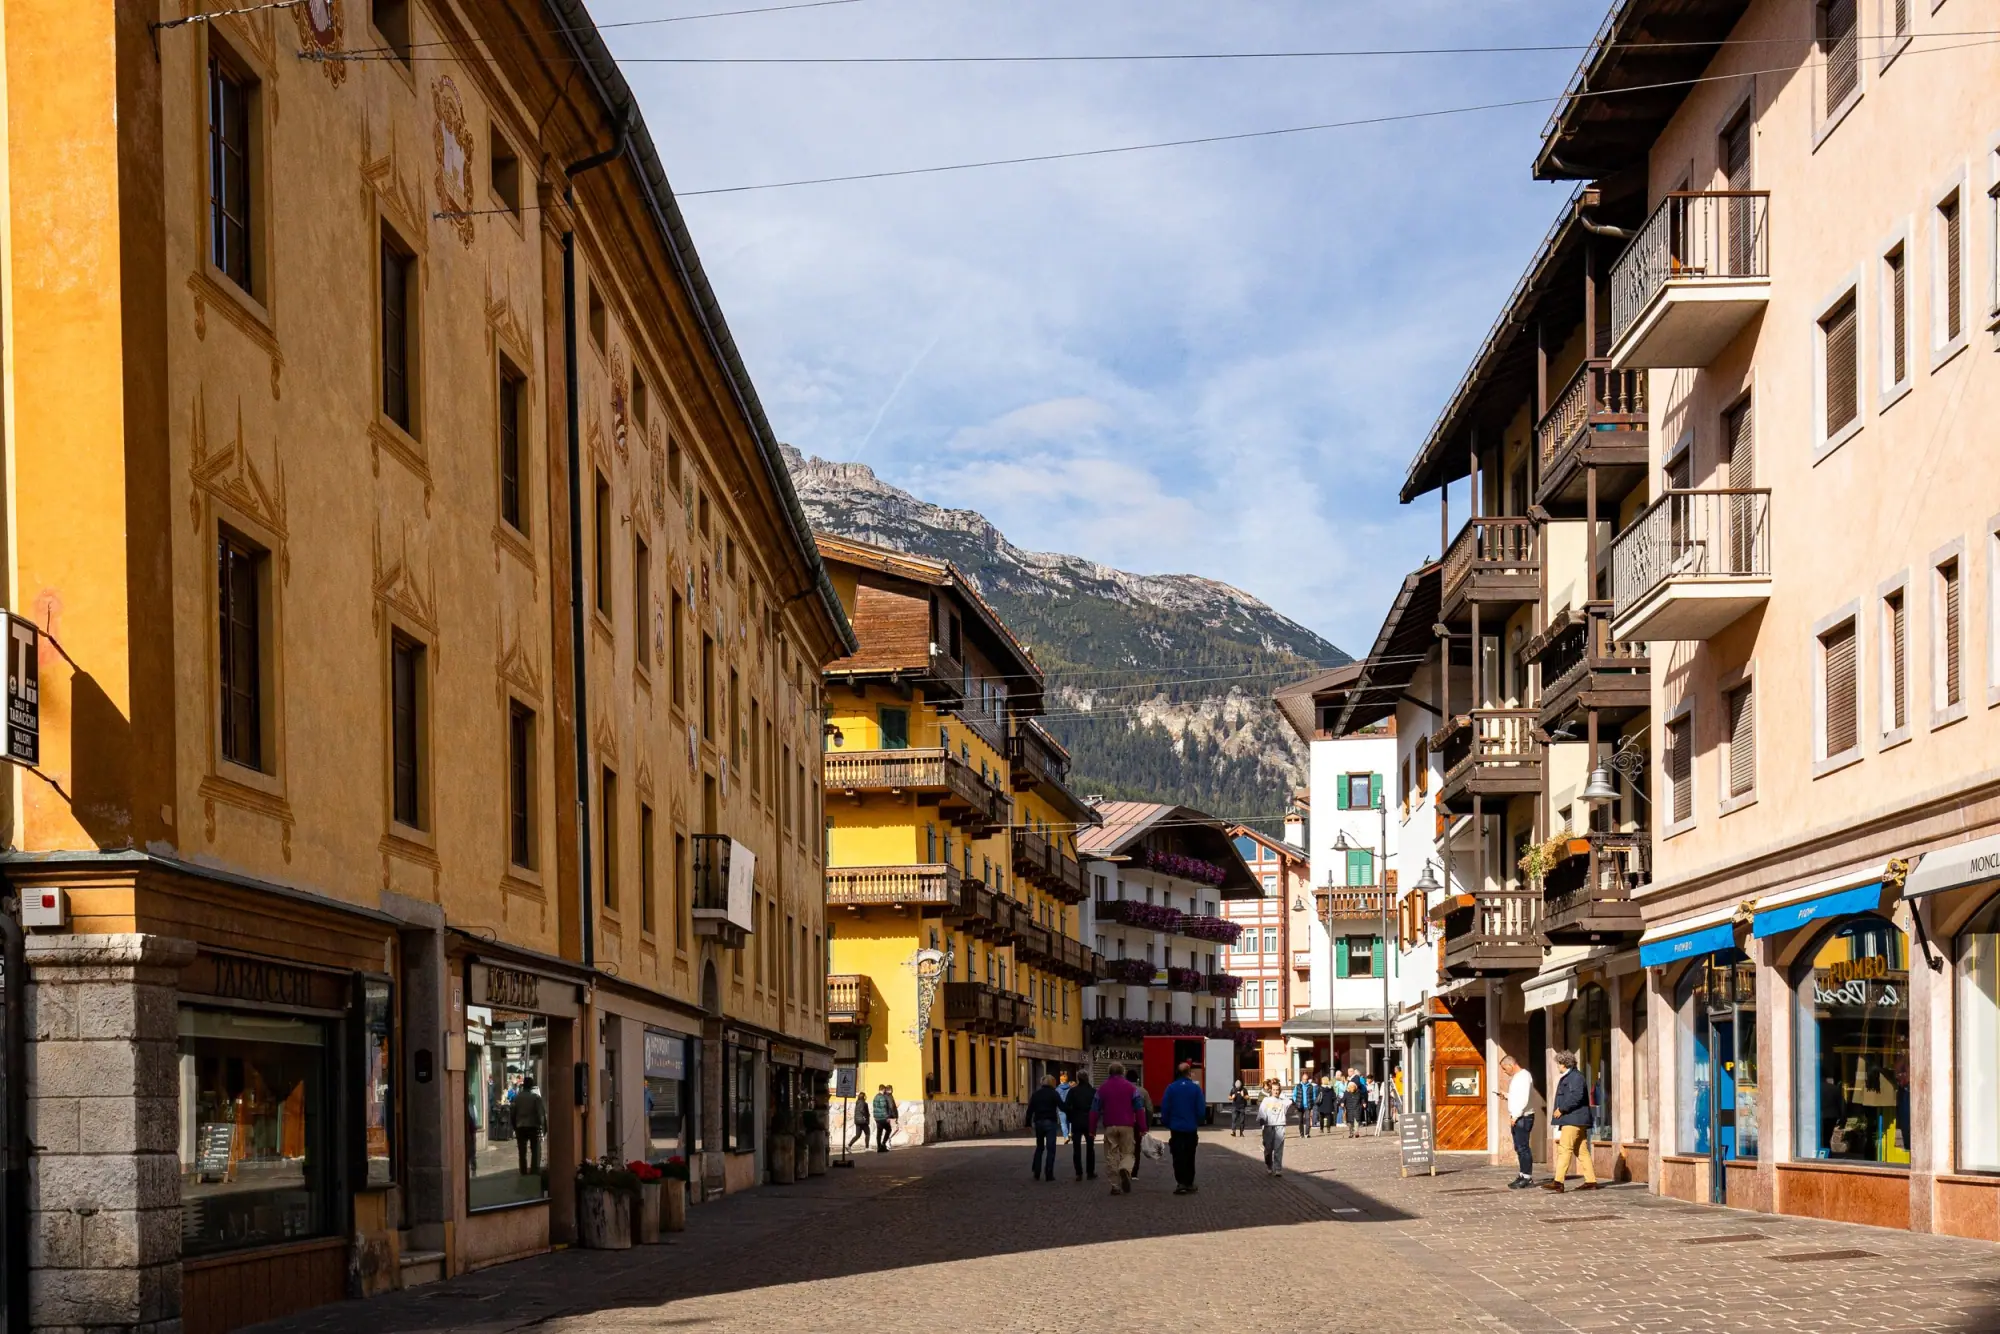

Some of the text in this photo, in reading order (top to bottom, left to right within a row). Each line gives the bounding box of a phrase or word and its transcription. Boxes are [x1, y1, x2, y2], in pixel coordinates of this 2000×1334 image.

[12, 622, 33, 700] T
[14, 699, 30, 713] SALI E
[9, 707, 37, 729] TABACCHI
[14, 731, 32, 746] VALORI
[13, 742, 33, 758] BOLLATI
[1674, 940, 1693, 953] PIOMBO
[1830, 954, 1887, 982] PIOMBO
[211, 955, 311, 1005] TABACCHI
